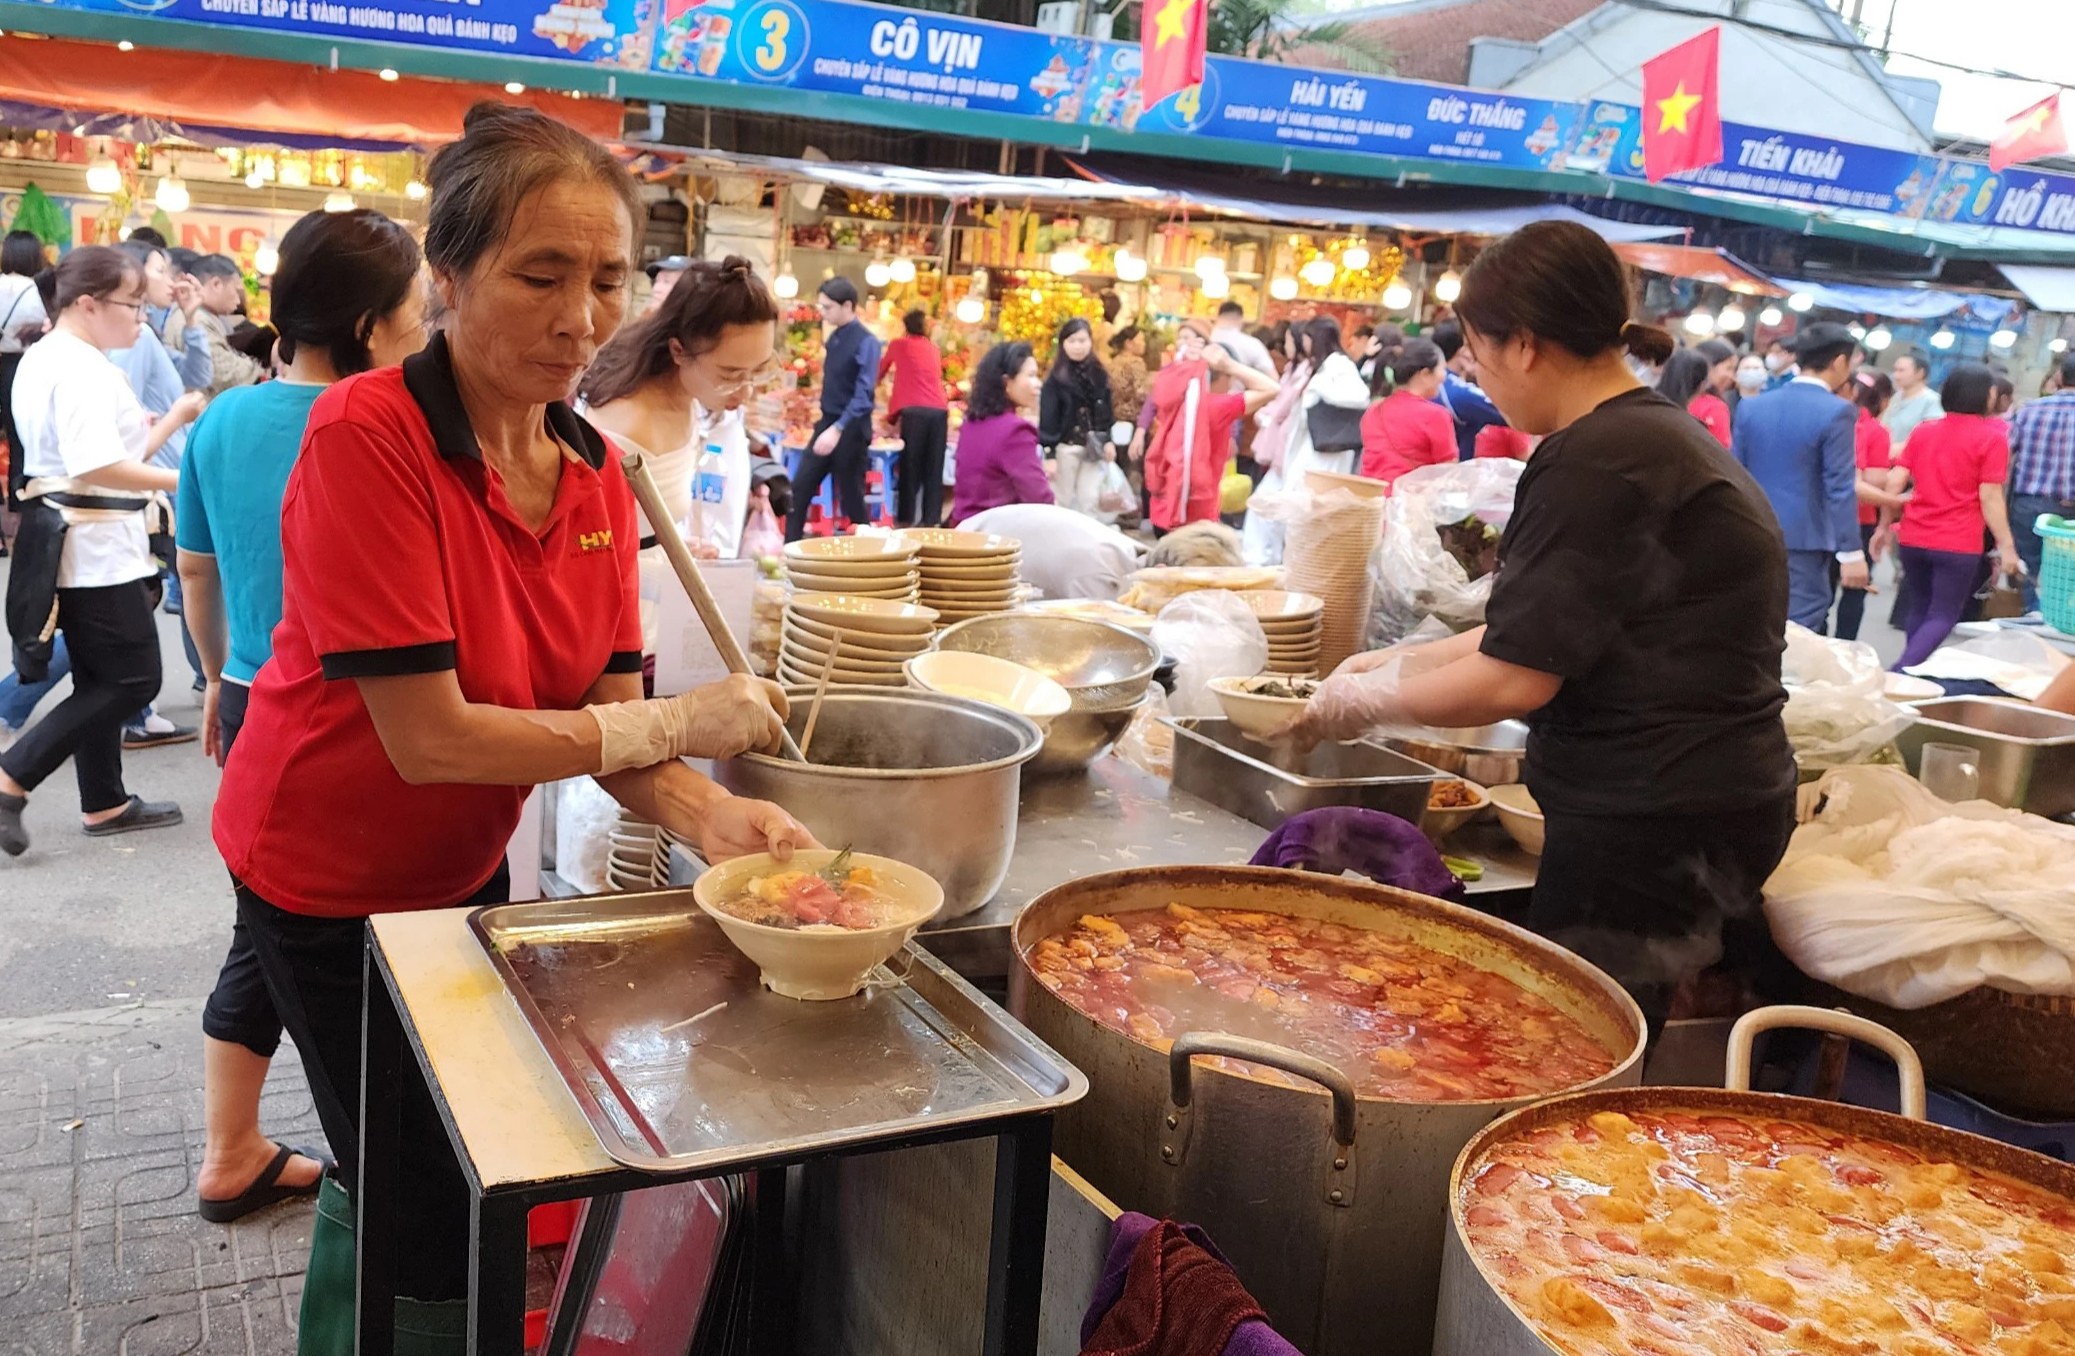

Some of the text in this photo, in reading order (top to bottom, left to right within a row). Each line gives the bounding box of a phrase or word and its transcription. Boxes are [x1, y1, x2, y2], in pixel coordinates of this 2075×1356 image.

[309, 0, 347, 25] VÀNG
[349, 6, 395, 30] HƯƠNG
[397, 12, 425, 34] HOA
[426, 13, 454, 37] QUẢ
[455, 16, 491, 40] BÁNH
[491, 23, 518, 45] KẸO
[755, 9, 790, 71] 3
[870, 17, 983, 73] CÔ VỊN
[1174, 83, 1201, 123] 4
[1289, 76, 1368, 113] HẢI YẾN
[1426, 94, 1528, 131] ĐỨC THẮNG
[1738, 135, 1845, 181] TIẾN KHẢI
[1972, 177, 1998, 217] 6
[1994, 178, 2048, 227] HỒ
